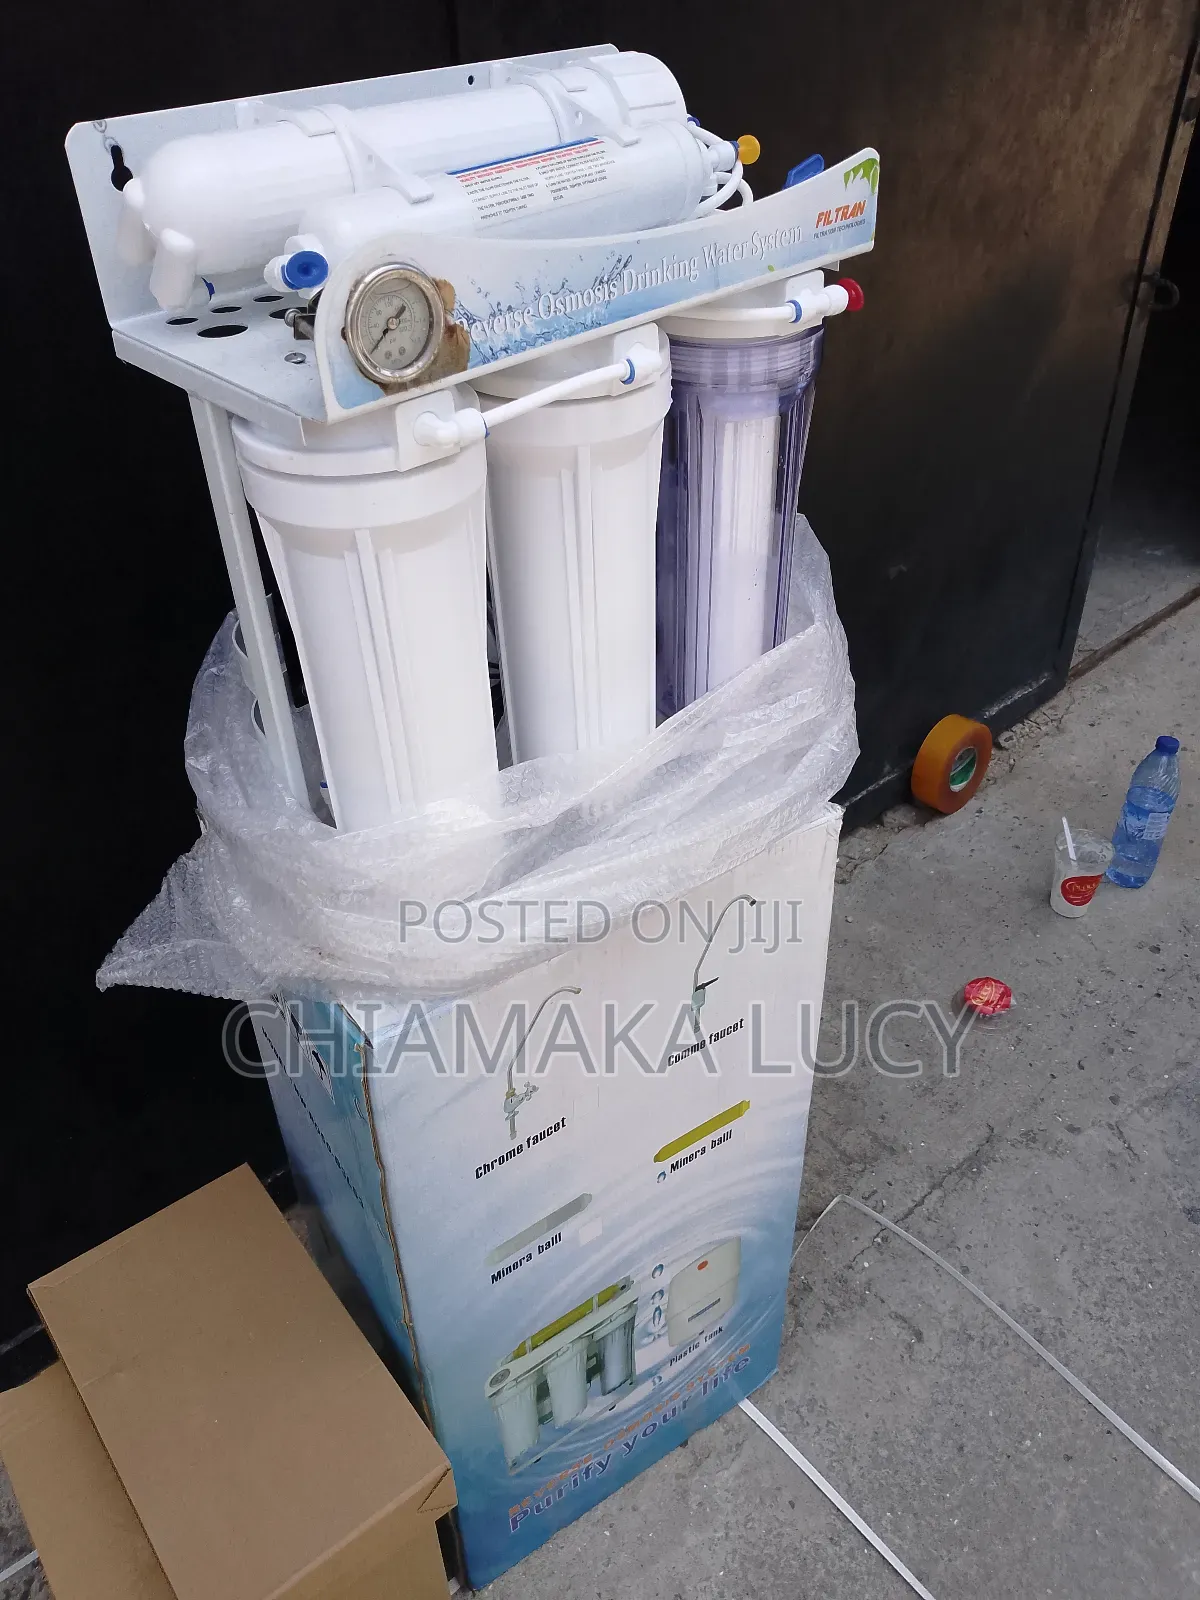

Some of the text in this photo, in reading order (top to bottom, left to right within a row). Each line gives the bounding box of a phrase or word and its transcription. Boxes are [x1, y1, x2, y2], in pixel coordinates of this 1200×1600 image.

[815, 200, 867, 229] FILTRAN
[538, 275, 618, 320] Osmosis
[621, 253, 699, 293] Drinking
[702, 241, 749, 269] Water
[750, 225, 803, 260] System
[667, 1018, 744, 1067] Comme faucet
[475, 1117, 567, 1180] Chrome faucet
[670, 1146, 706, 1173] Minera
[491, 1251, 533, 1284] Minera
[669, 1326, 724, 1367] Plastic tank
[510, 1356, 750, 1533] Purify your life
